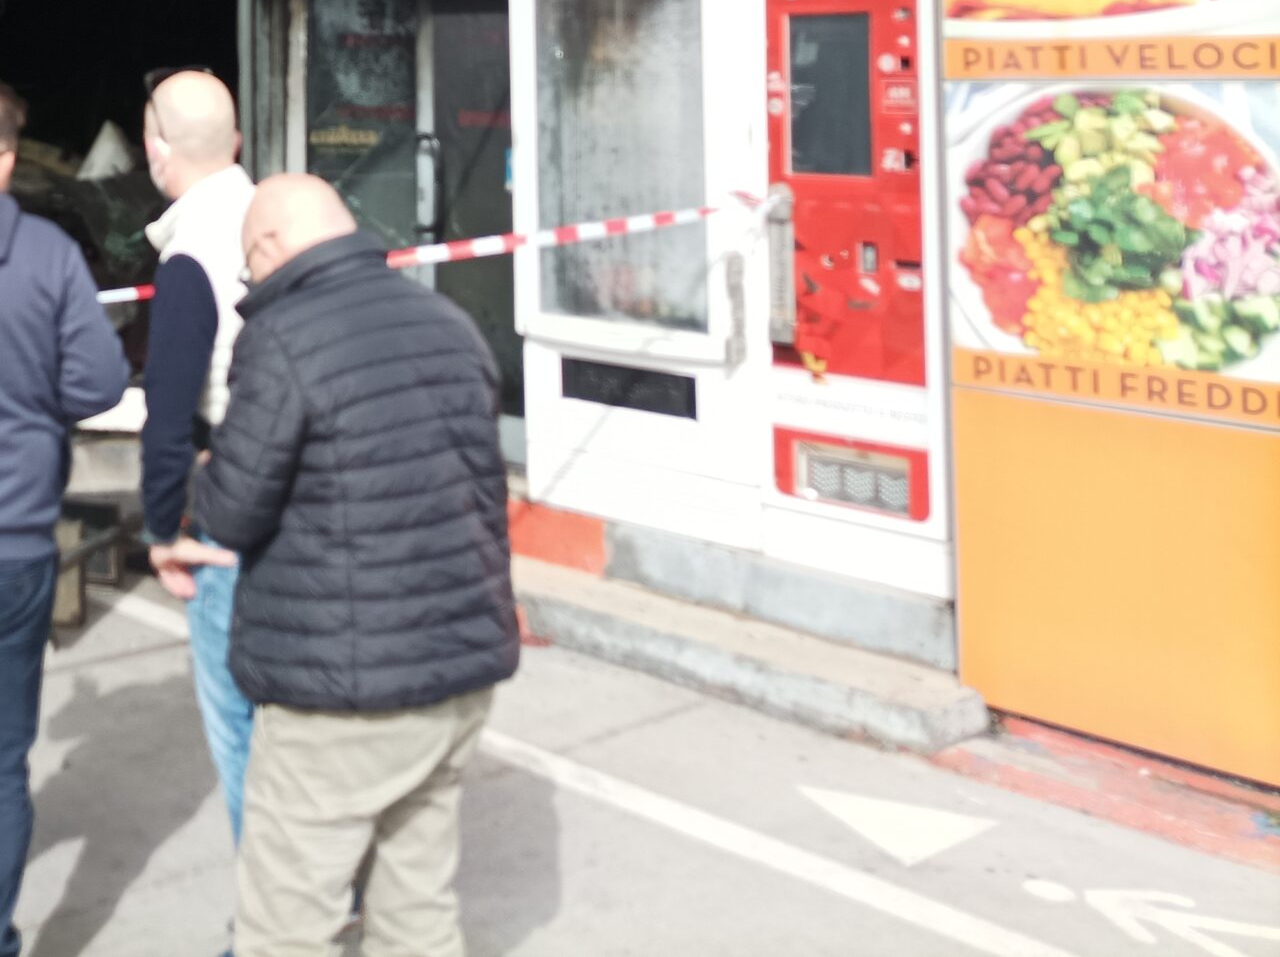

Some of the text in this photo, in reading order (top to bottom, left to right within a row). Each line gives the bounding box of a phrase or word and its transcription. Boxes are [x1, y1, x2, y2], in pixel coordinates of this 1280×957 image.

[962, 41, 1278, 72] PIATTI VELOCI
[972, 354, 1101, 396] PIATTI
